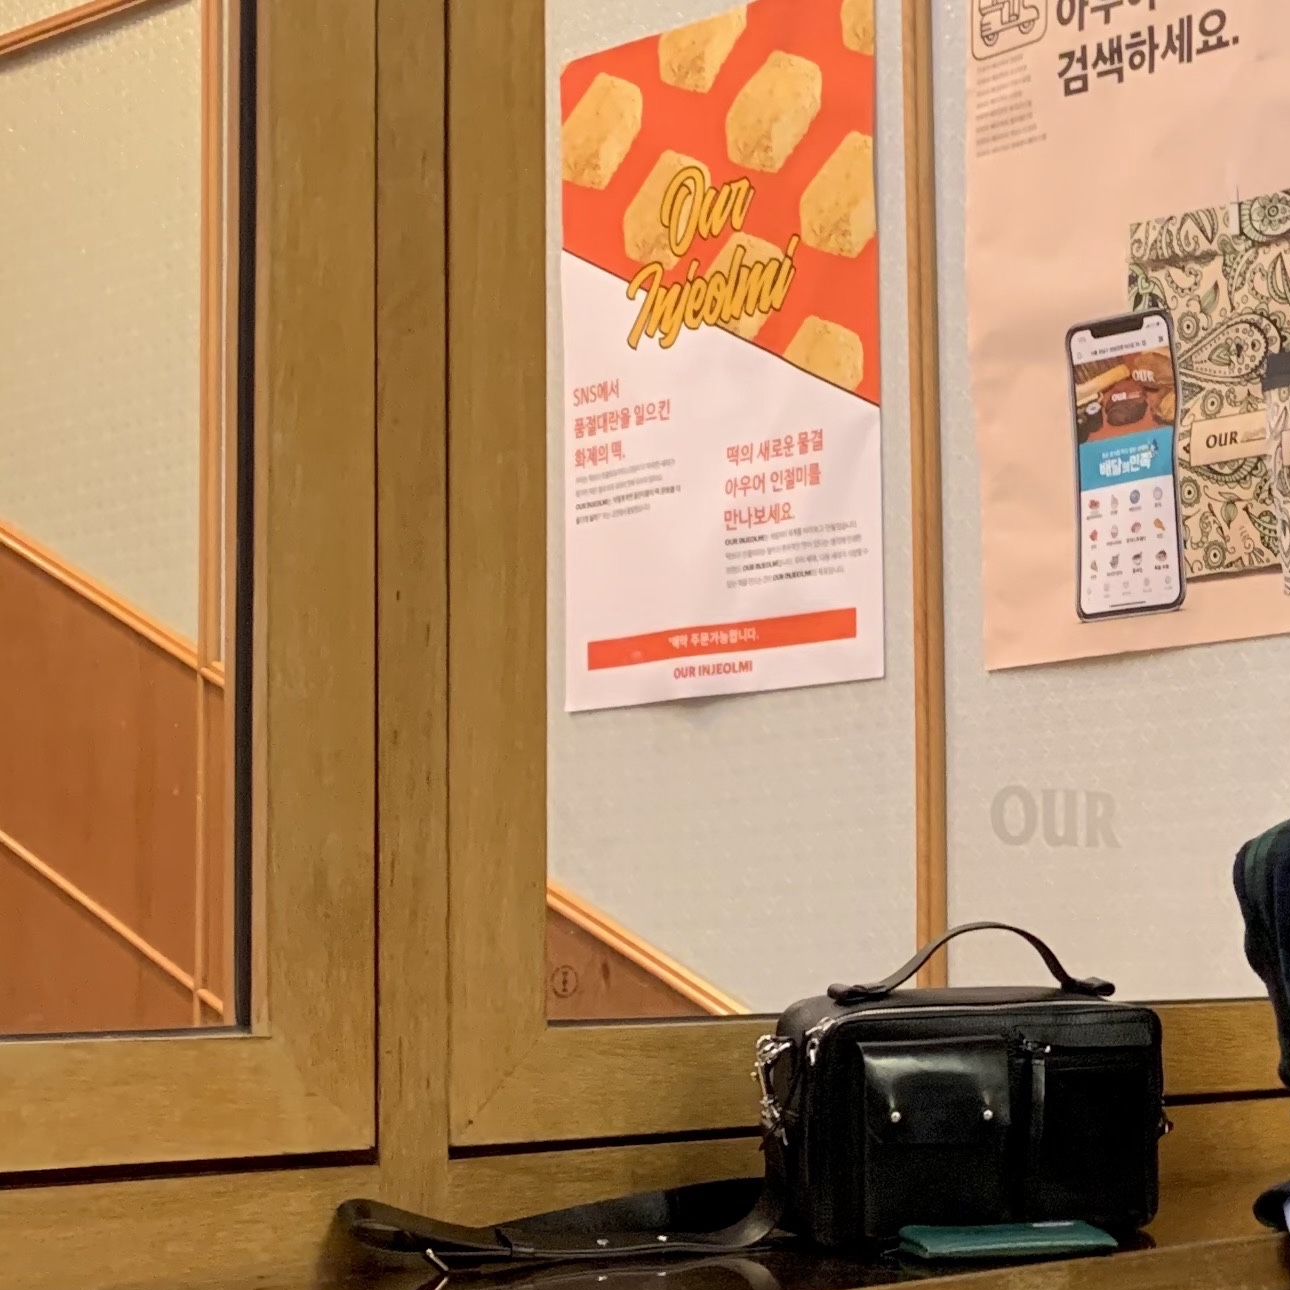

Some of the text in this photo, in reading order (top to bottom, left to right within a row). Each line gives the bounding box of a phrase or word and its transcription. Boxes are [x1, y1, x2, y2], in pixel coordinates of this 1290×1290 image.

[1057, 9, 1239, 97] 검색하세요.
[660, 165, 756, 257] Our
[626, 233, 801, 350] Injeolmi
[573, 378, 620, 407] SNS에서
[574, 398, 670, 439] 품절대란을 일으킨
[574, 443, 609, 469] 화제의
[726, 428, 824, 466] 떡의 새로운 물결
[1205, 431, 1239, 449] OUR
[725, 462, 821, 498] 아우어 인절미를
[723, 502, 795, 531] 만나보세요.
[673, 660, 753, 680] OUR INJEOLMI
[990, 785, 1123, 849] OUR
